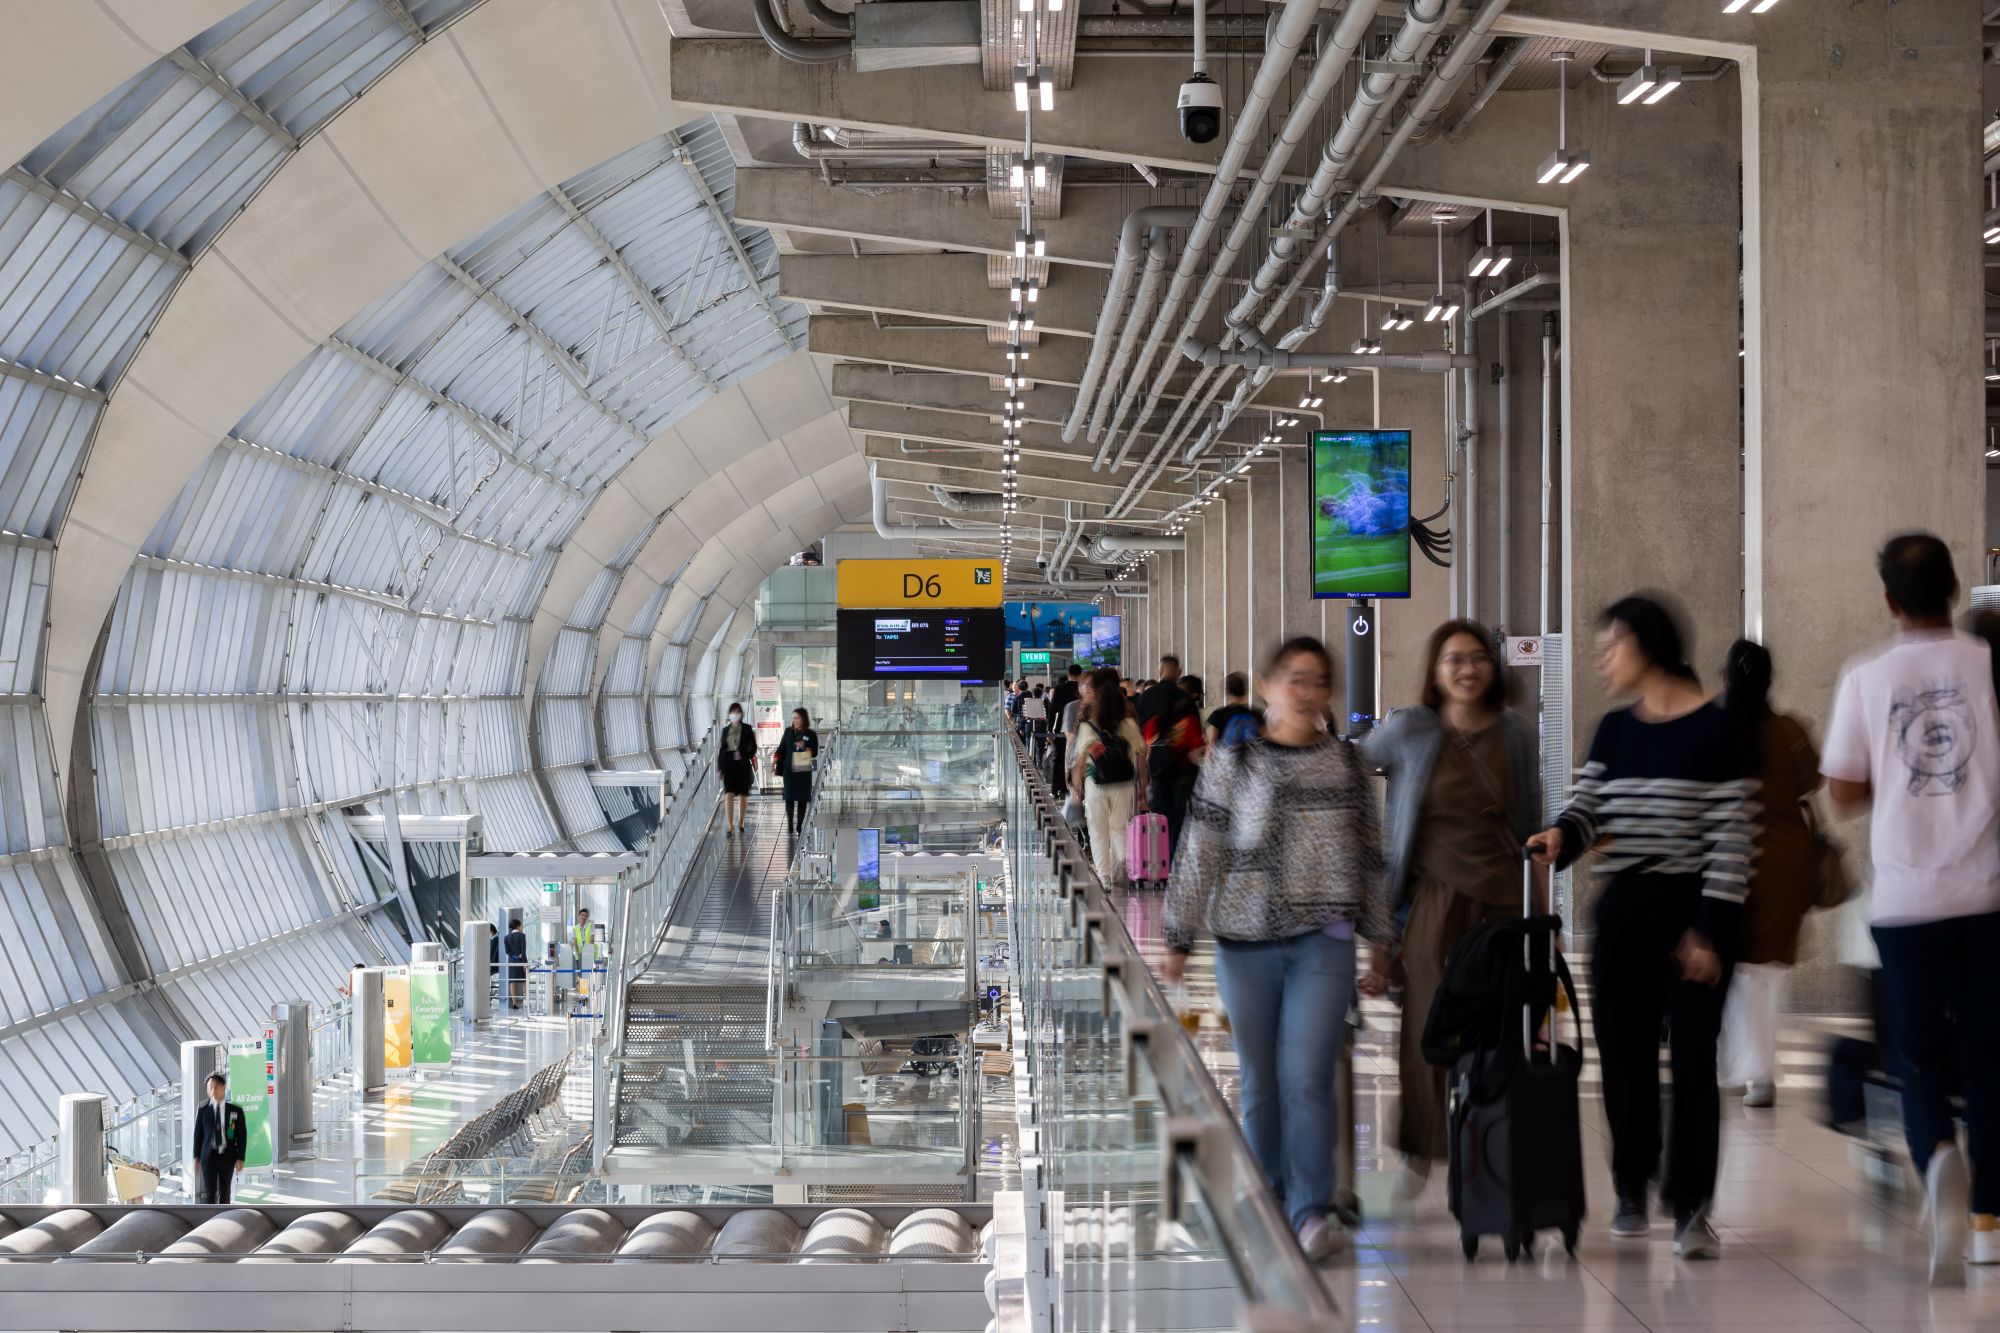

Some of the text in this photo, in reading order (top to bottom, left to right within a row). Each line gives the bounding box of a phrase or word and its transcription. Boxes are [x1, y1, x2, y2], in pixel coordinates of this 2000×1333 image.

[903, 573, 942, 598] D6
[415, 1005, 445, 1014] Courtesy
[237, 1094, 263, 1102] All Zone
